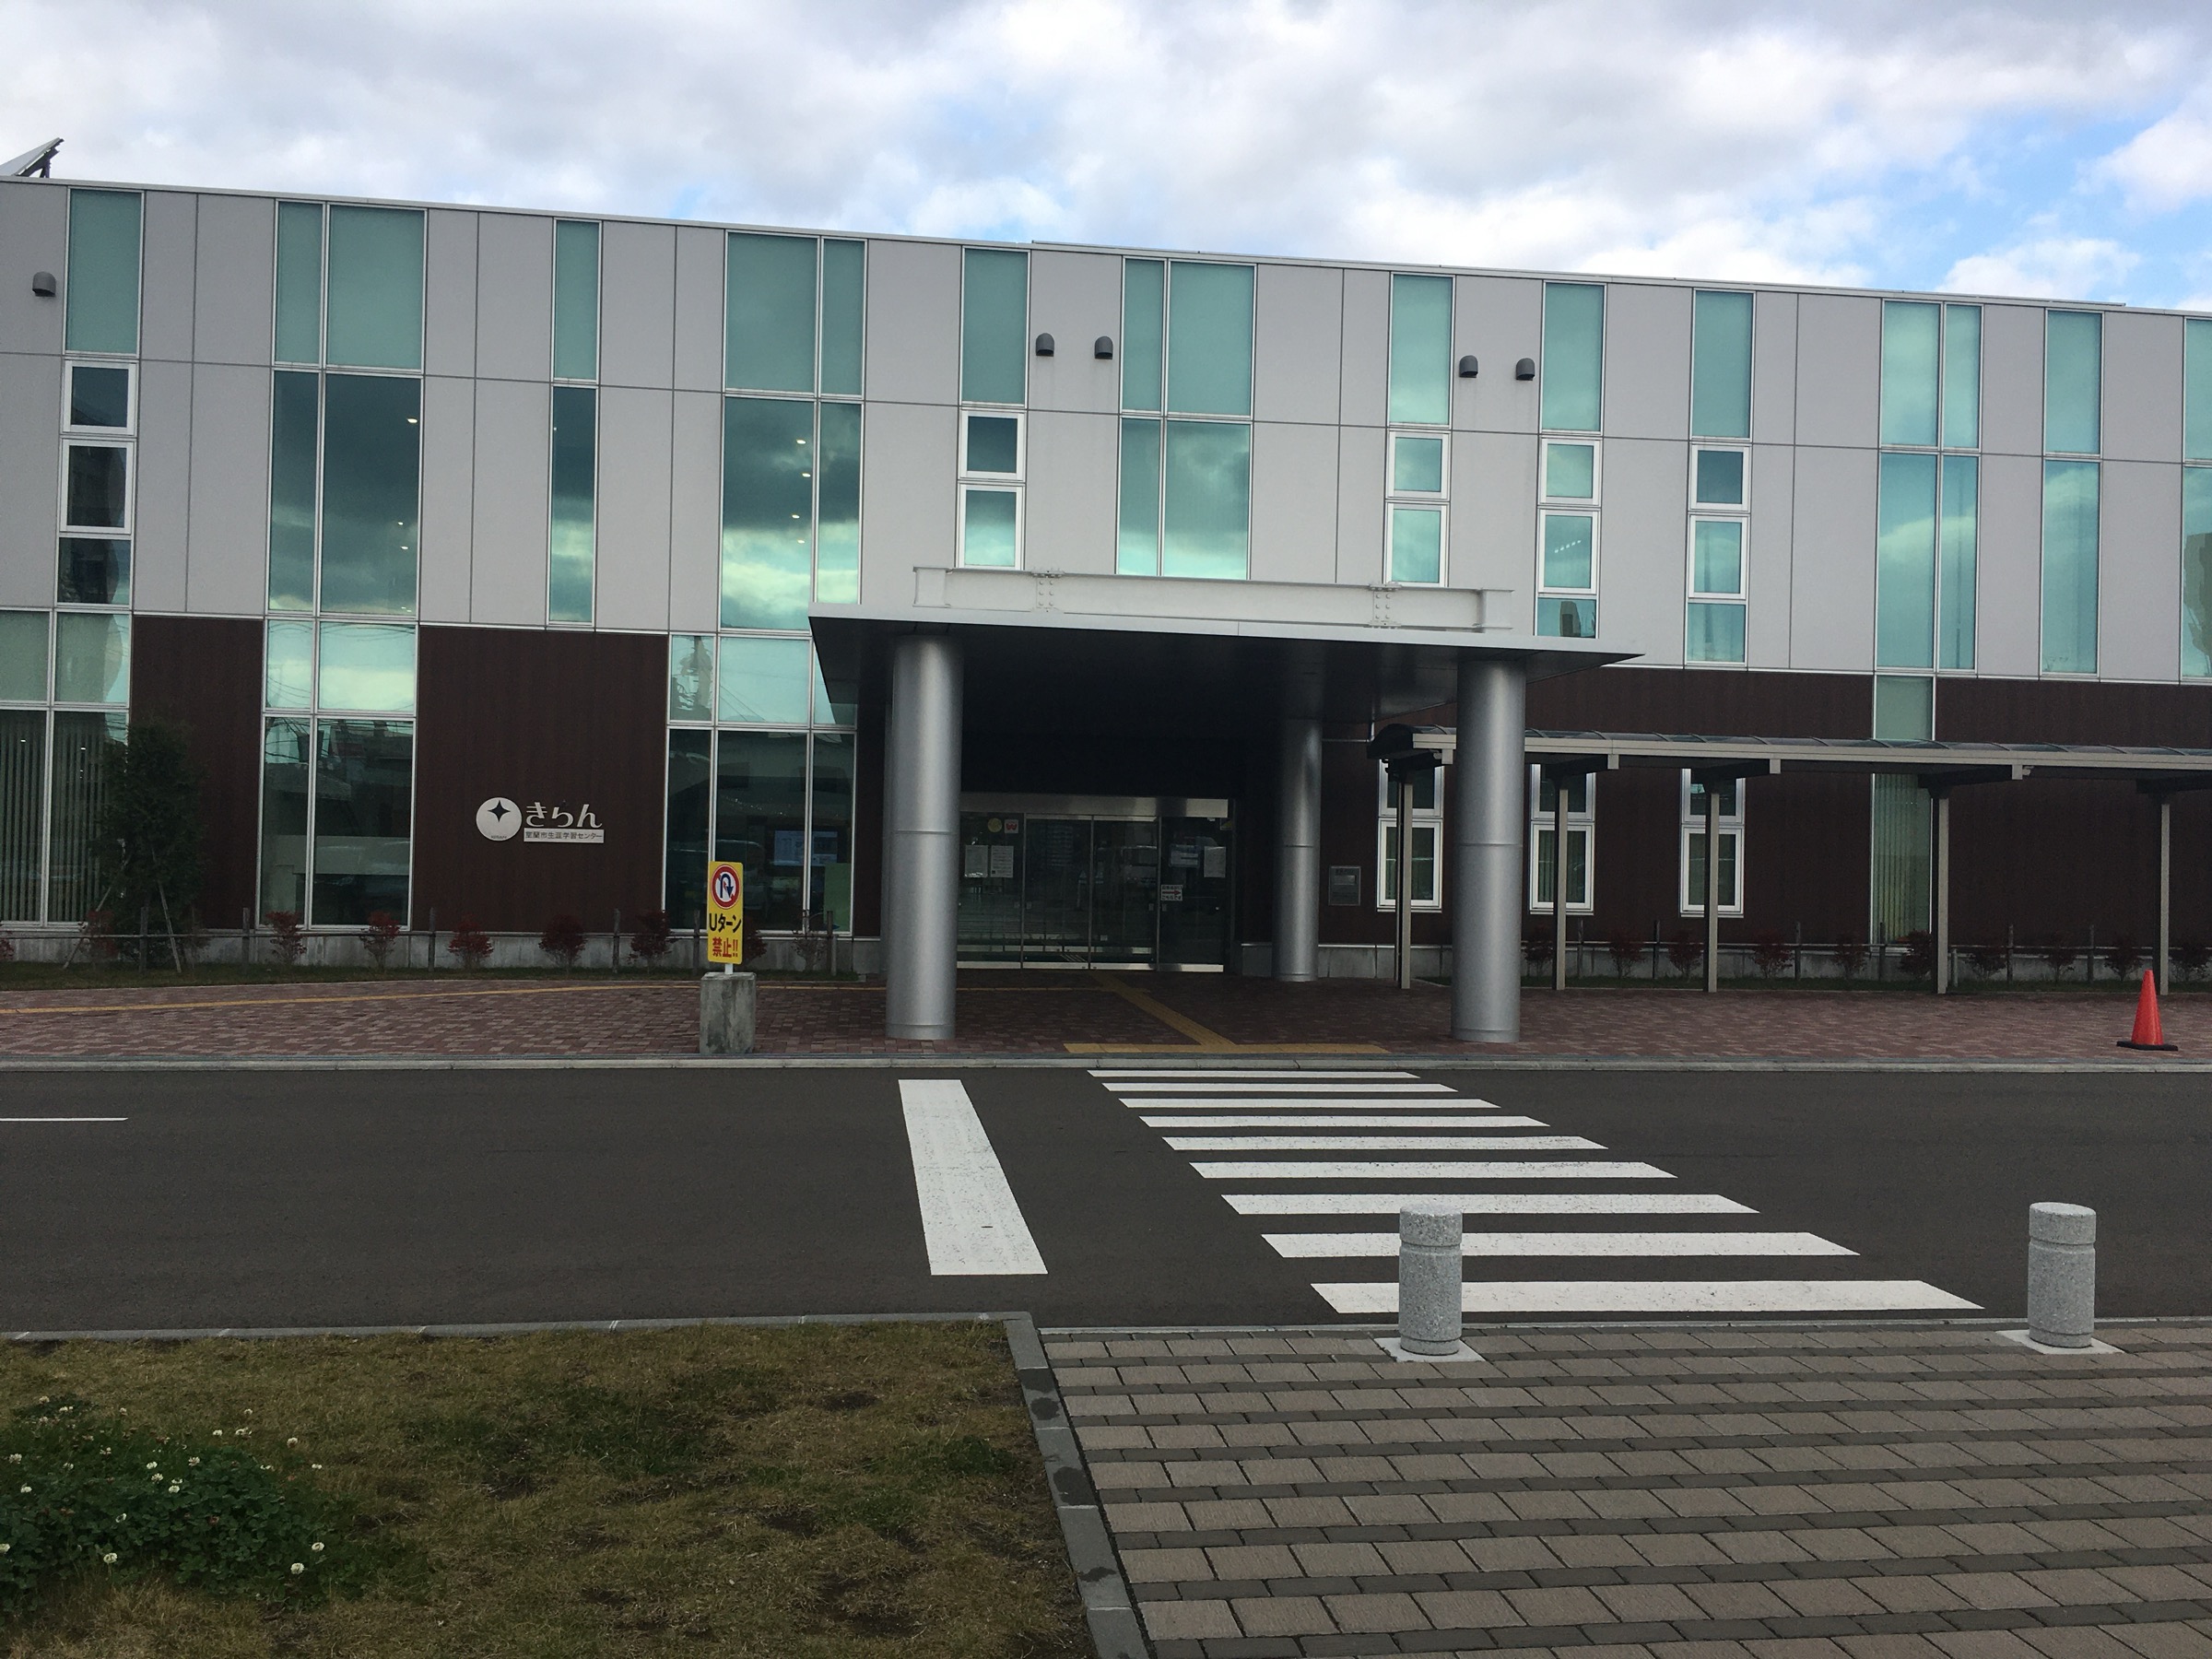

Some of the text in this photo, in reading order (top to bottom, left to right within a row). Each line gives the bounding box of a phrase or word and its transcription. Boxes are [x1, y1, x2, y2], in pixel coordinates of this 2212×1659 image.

[525, 802, 603, 828] きらん
[525, 831, 603, 841] 室蘭市生涯学習センター
[709, 912, 742, 933] Uターン
[712, 936, 738, 958] 禁止!!
